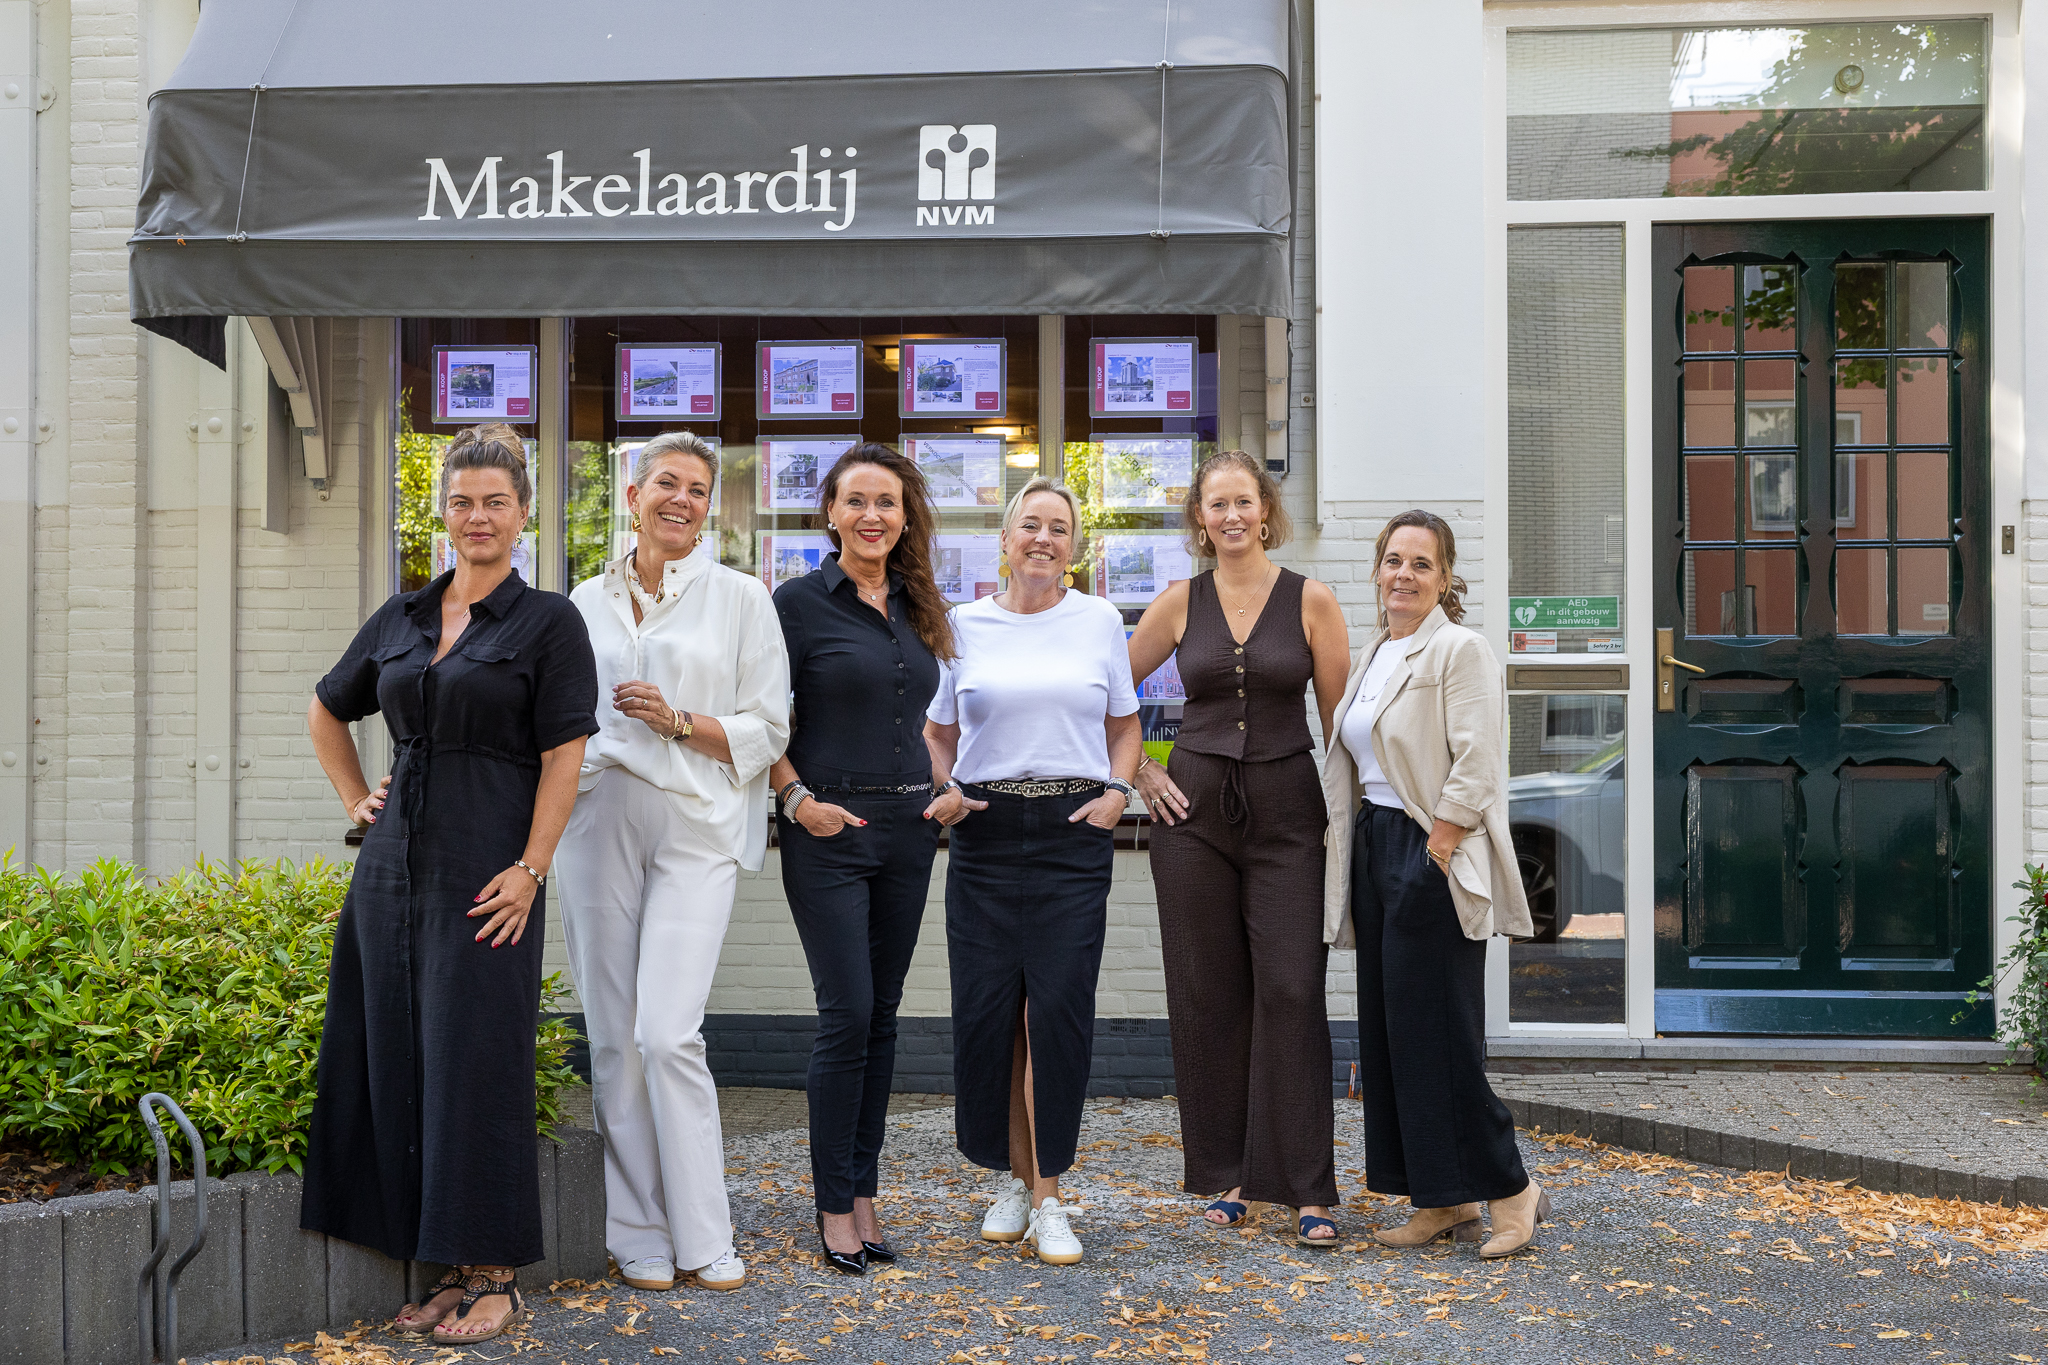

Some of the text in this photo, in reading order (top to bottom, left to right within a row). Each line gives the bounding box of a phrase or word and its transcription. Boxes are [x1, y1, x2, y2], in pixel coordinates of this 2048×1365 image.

[418, 144, 858, 231] Makelaardij
[916, 205, 995, 226] NVM
[924, 441, 945, 463] VERKOCHT
[1568, 599, 1588, 607] AED
[1573, 608, 1610, 617] gebouw
[1557, 617, 1600, 626] aanwezig
[1165, 727, 1179, 735] NV
